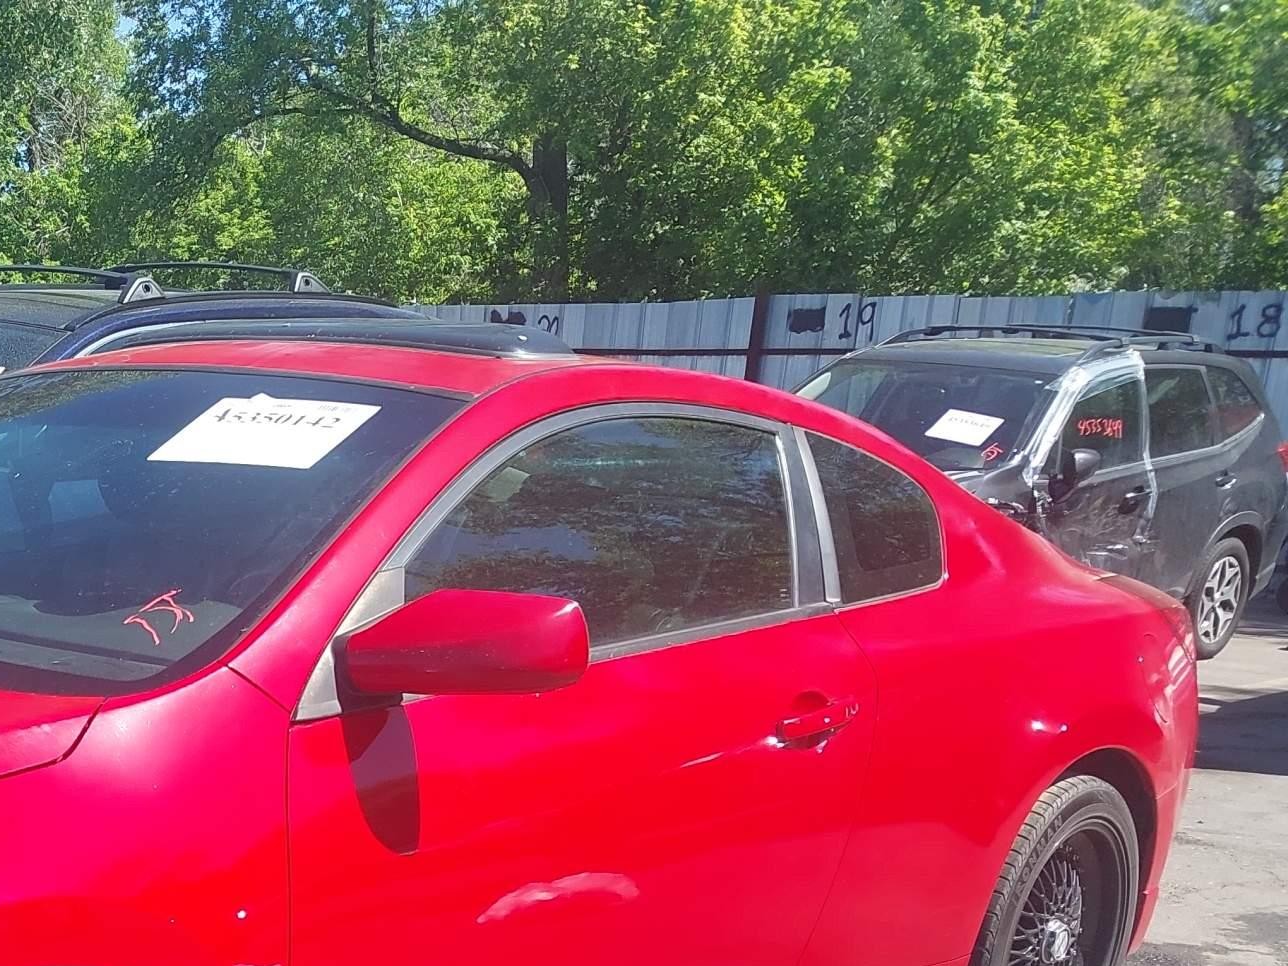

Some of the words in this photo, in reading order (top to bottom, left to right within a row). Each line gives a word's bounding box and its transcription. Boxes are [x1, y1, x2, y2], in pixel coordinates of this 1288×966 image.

[838, 302, 877, 341] 19
[1226, 304, 1283, 340] 18
[215, 407, 341, 428] 45350142
